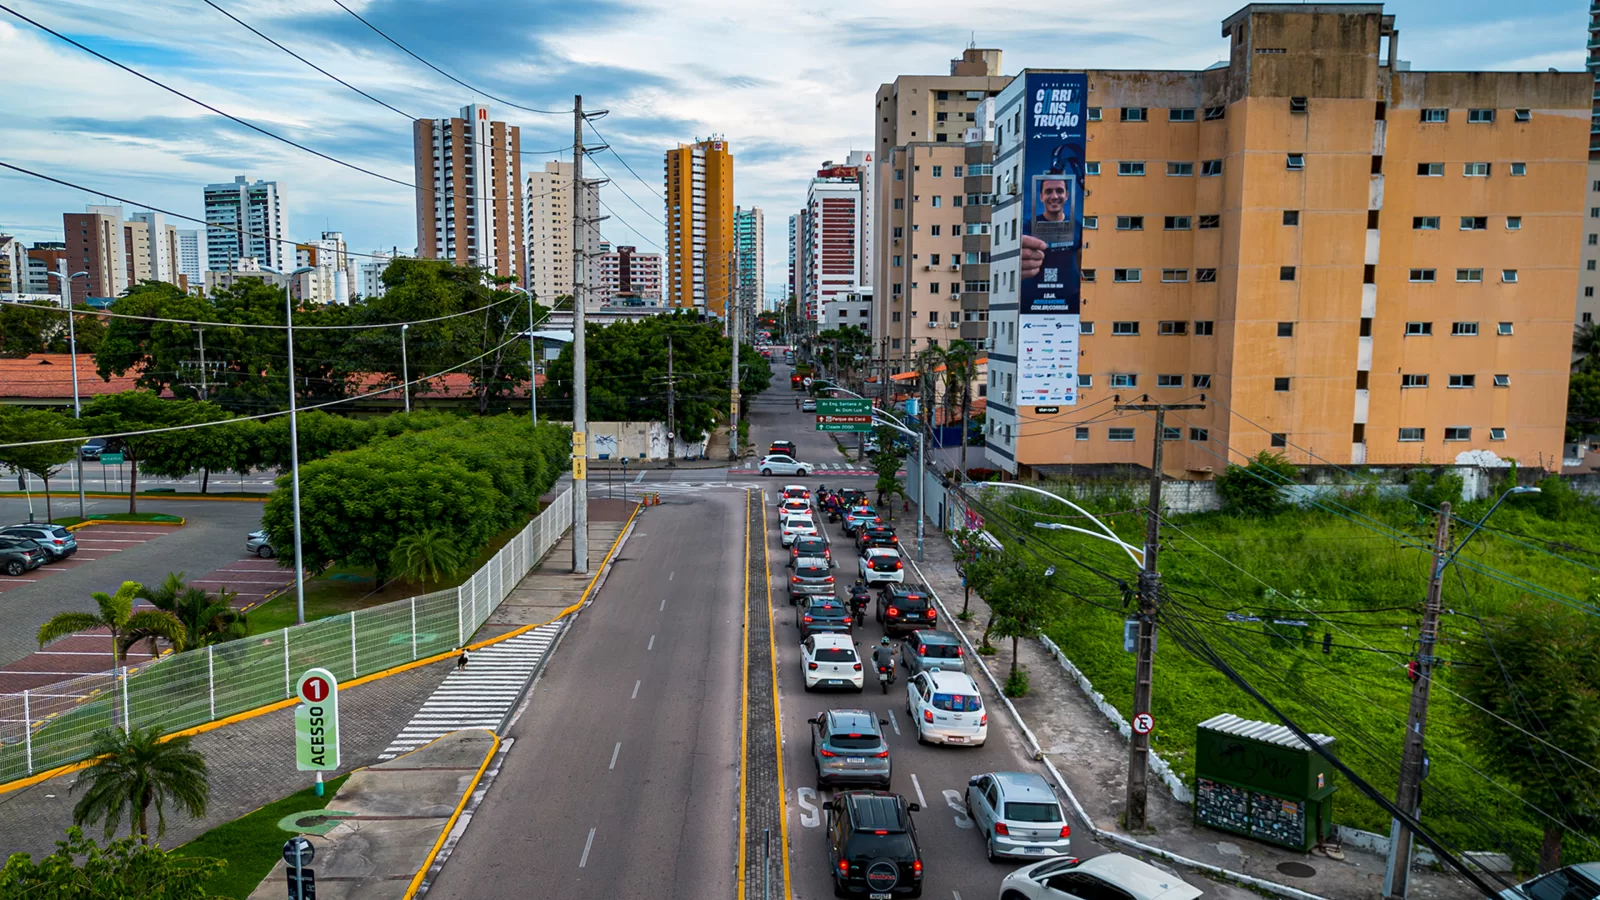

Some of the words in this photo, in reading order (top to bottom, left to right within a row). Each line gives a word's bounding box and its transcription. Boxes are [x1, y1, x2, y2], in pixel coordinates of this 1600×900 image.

[1034, 112, 1079, 130] TRUÇÃO
[309, 679, 321, 699] 1
[310, 706, 325, 766] ACESSO
